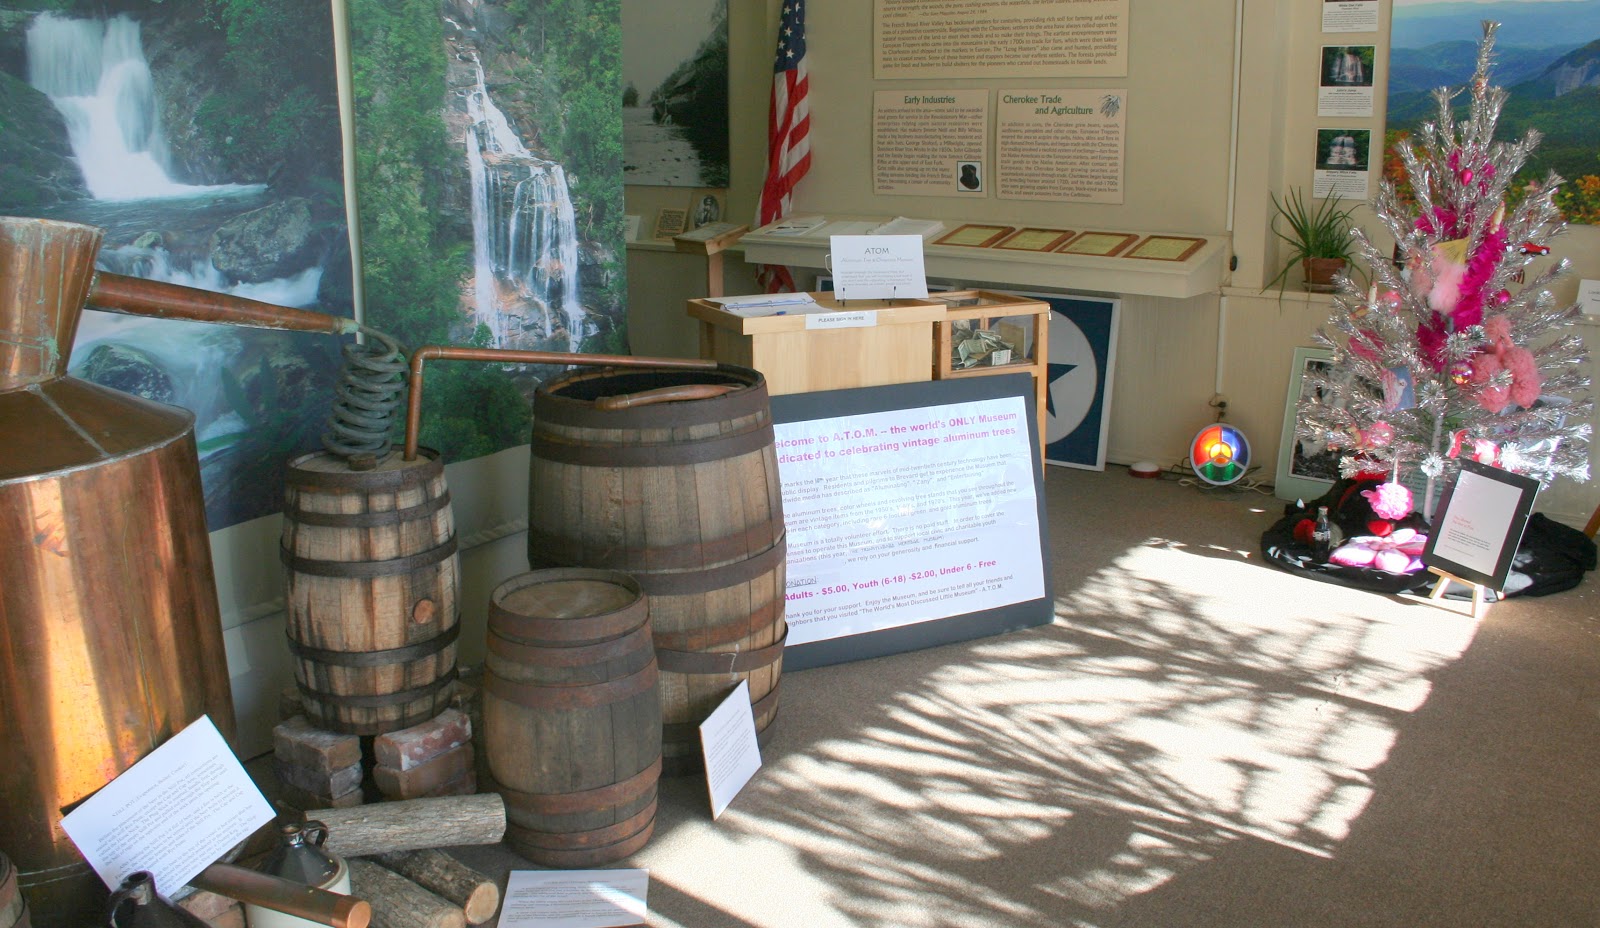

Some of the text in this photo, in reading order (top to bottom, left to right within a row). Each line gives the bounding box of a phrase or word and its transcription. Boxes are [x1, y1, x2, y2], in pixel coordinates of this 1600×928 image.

[904, 96, 955, 105] Early Industries
[1003, 95, 1062, 104] Cherokee Trade
[1050, 107, 1093, 116] Agriculture
[775, 413, 1017, 448] elcome to A.T.O.M. the world's ONLY Museum
[778, 428, 1015, 463] dicated to celebrating vintage aluminum trees
[823, 481, 852, 489] Residents
[978, 482, 1005, 490] throughout
[833, 487, 862, 496] described
[812, 544, 835, 553] operate
[894, 531, 916, 539] support
[891, 546, 920, 556] generosity
[934, 540, 956, 548] financial
[784, 590, 813, 601] Adults
[821, 583, 849, 594] $5.00,
[852, 578, 878, 589] Youth
[881, 573, 906, 586] (6-18)
[939, 564, 964, 574] Under
[978, 559, 996, 568] Free
[839, 609, 858, 617] visited
[910, 595, 938, 604] Discussed
